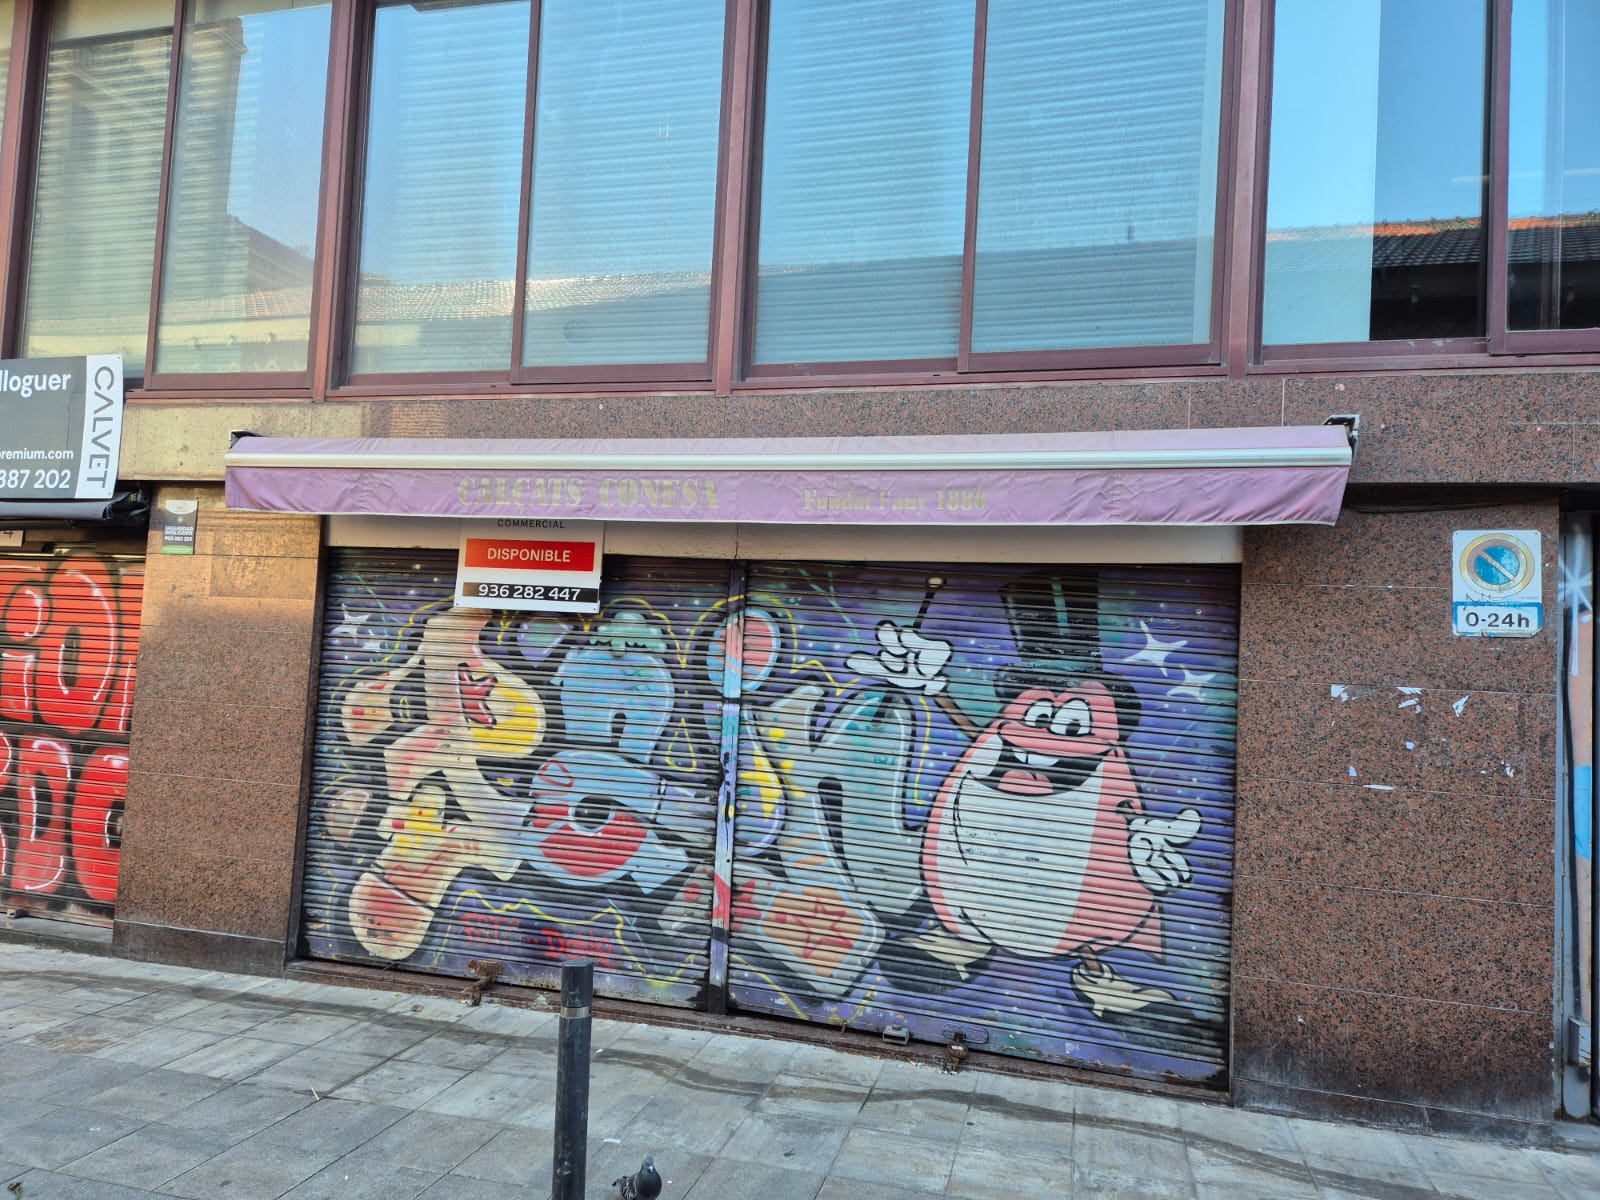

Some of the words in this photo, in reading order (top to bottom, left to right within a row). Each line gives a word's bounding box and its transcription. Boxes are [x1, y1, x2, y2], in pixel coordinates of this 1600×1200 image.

[86, 366, 115, 488] CALVET
[0, 447, 74, 460] remium.com
[33, 469, 71, 489] 202
[458, 476, 584, 513] CALÇATS
[600, 477, 719, 509] CONESA
[497, 518, 565, 529] COMMERCIAL
[487, 547, 571, 563] DISPONIBLE
[478, 583, 509, 598] 936
[513, 585, 544, 599] 282
[548, 586, 581, 601] 447
